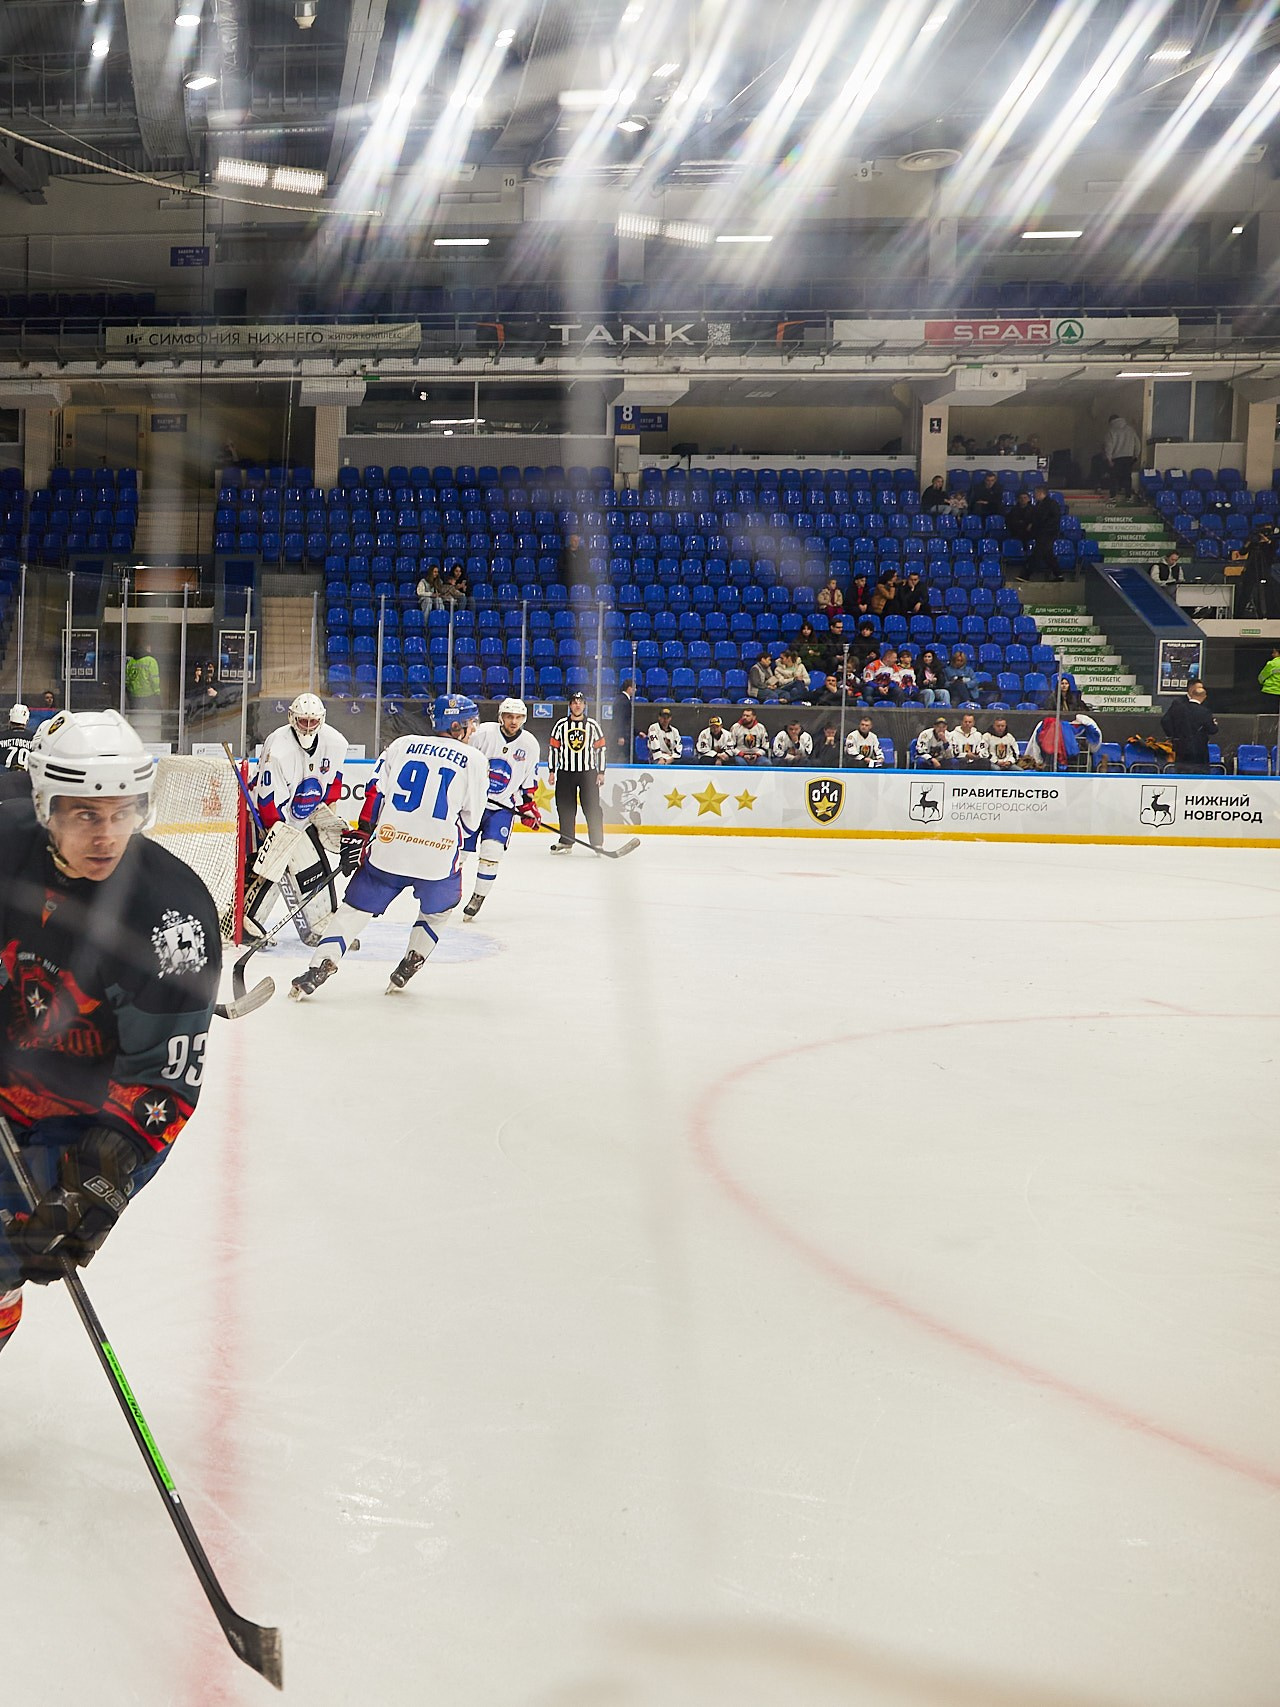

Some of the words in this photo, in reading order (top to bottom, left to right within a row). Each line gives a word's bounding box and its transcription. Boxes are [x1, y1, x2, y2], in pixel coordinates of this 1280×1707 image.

[149, 333, 240, 346] СИМФОНИЯ
[248, 331, 324, 345] НИЖНЕГО
[549, 324, 696, 346] TANK
[953, 324, 1049, 341] SPAR
[622, 405, 633, 421] 8
[406, 743, 469, 769] АЛЕКСЕЕВ
[260, 770, 272, 787] 0
[392, 760, 456, 820] 91
[811, 781, 839, 802] ОХЛ
[952, 788, 1059, 799] ПРАВИТЕЛЬСТВО
[952, 800, 1048, 812] НИЖЕГОРОДСКОЙ
[1185, 794, 1250, 807] НИЖНИЙ
[951, 812, 1001, 821] ОБЛАСТИ
[1184, 810, 1263, 823] НОВГОРОД
[258, 830, 276, 865] CCM
[303, 872, 324, 886] CCM
[161, 1033, 208, 1088] 93
